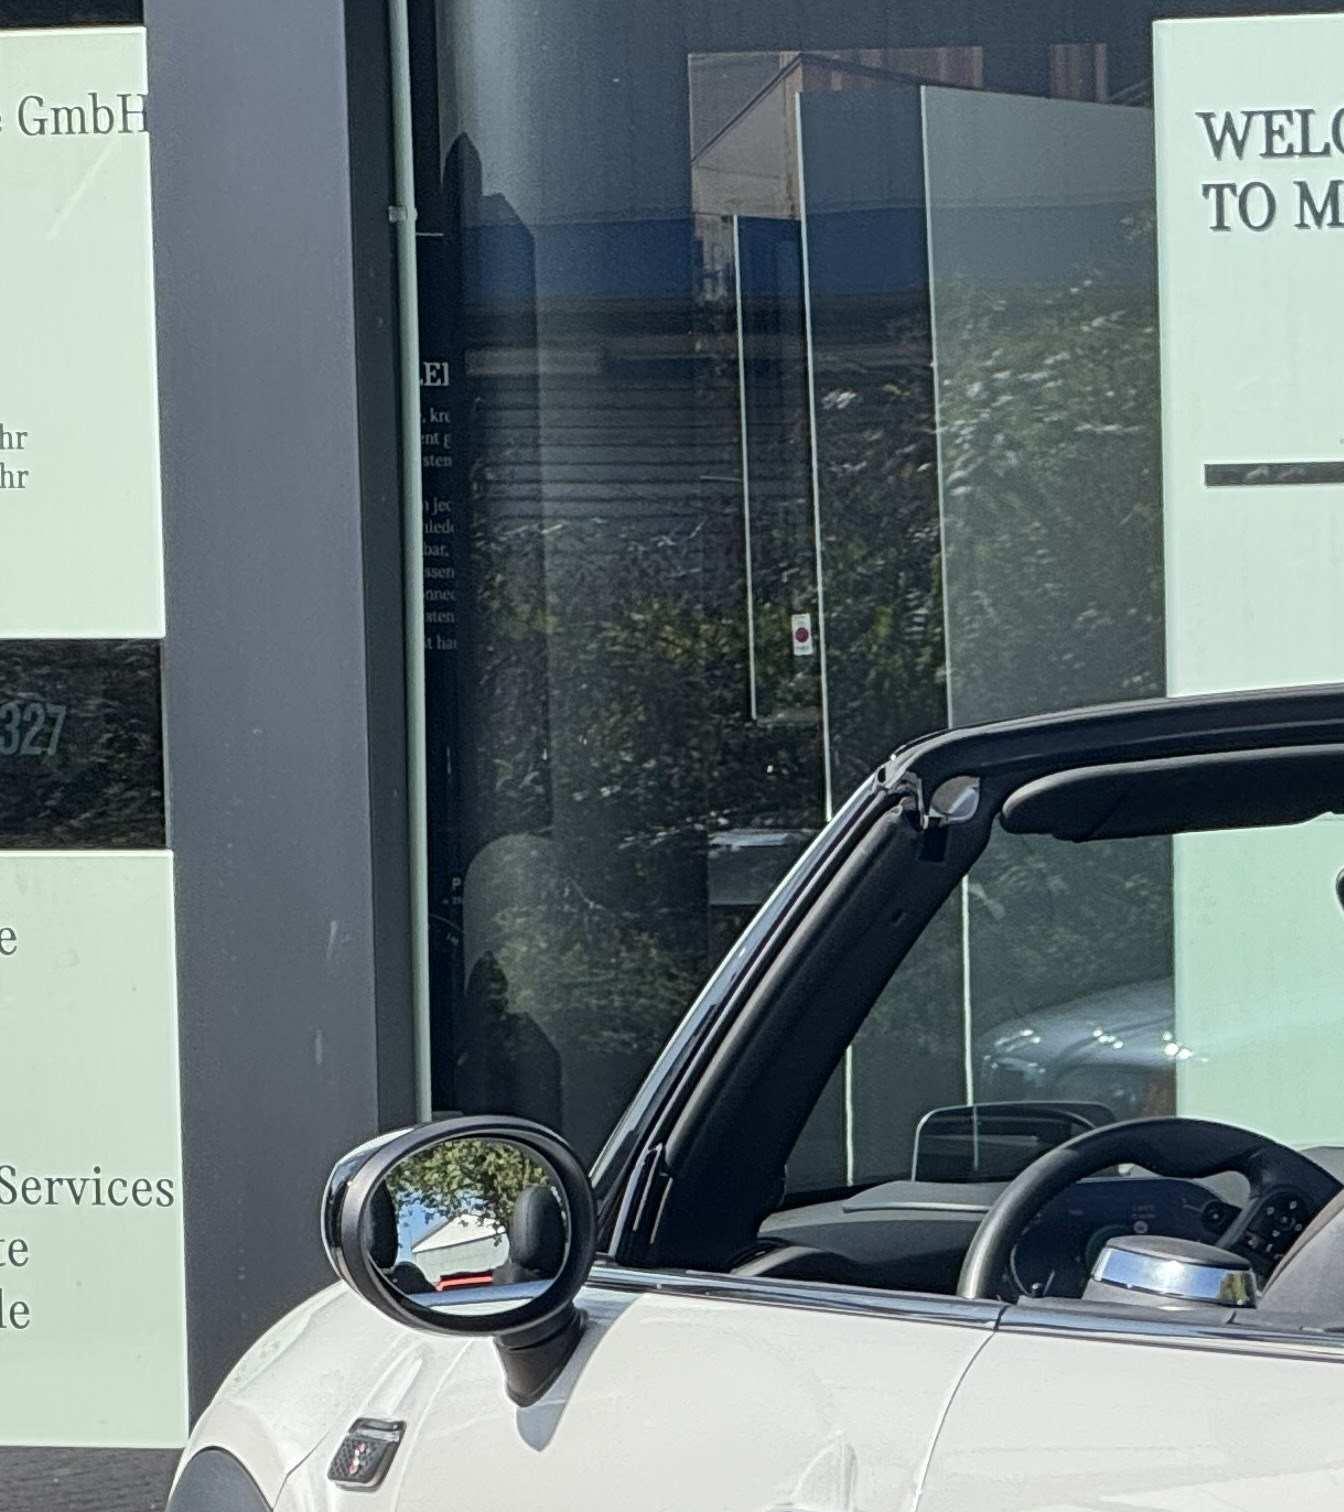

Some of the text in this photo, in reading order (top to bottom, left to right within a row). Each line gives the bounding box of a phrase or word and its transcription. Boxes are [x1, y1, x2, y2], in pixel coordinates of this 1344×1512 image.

[18, 92, 149, 136] GmbH
[1202, 181, 1276, 232] TO
[0, 1164, 175, 1208] Services
